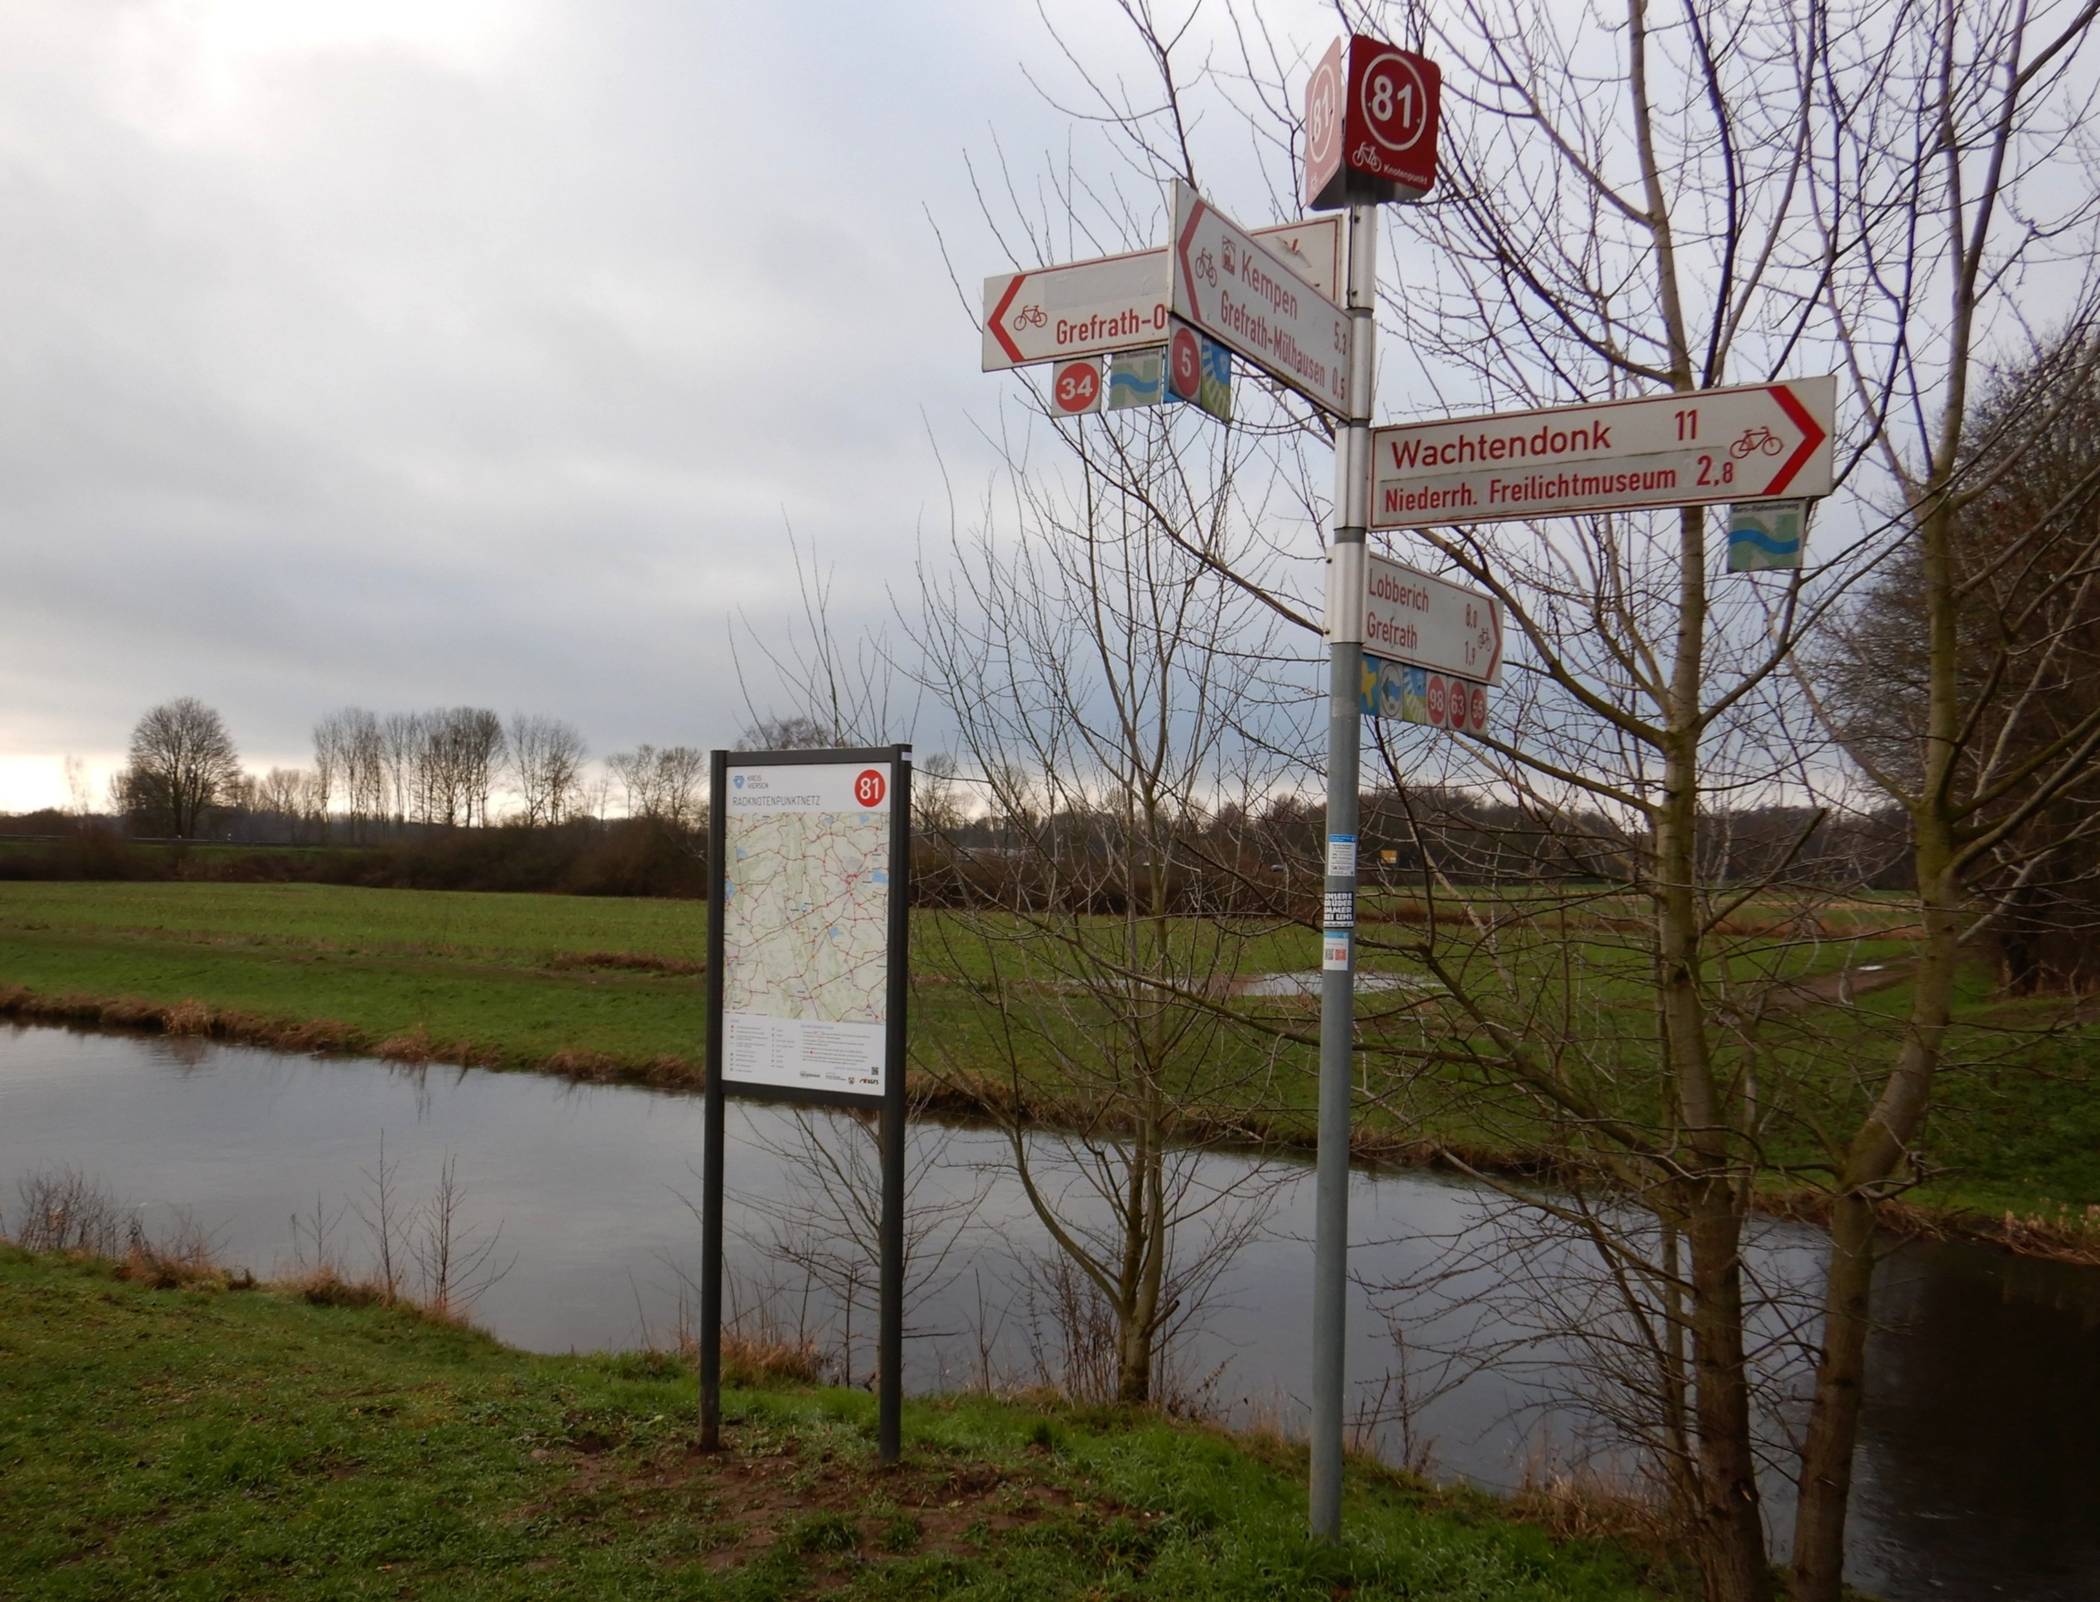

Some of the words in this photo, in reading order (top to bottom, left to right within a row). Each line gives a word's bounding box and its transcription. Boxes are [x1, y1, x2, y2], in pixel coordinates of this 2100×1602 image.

[1313, 84, 1330, 144] 81
[1371, 75, 1413, 129] 81
[1241, 250, 1298, 320] Kempen
[1180, 346, 1193, 378] 5
[1220, 289, 1326, 389] Grefrath-Mülhausen
[1060, 375, 1093, 401] 34
[1391, 419, 1612, 470] Wachtendonk
[1674, 408, 1698, 442] 11
[1384, 481, 1478, 514] Niederrh.
[1489, 467, 1677, 504] Freilichtmuseum
[1696, 454, 1734, 487] 2,8
[1368, 568, 1429, 613] Lobberich
[1366, 612, 1418, 650] Grefrath
[1430, 689, 1444, 713] 98
[859, 777, 880, 800] 81
